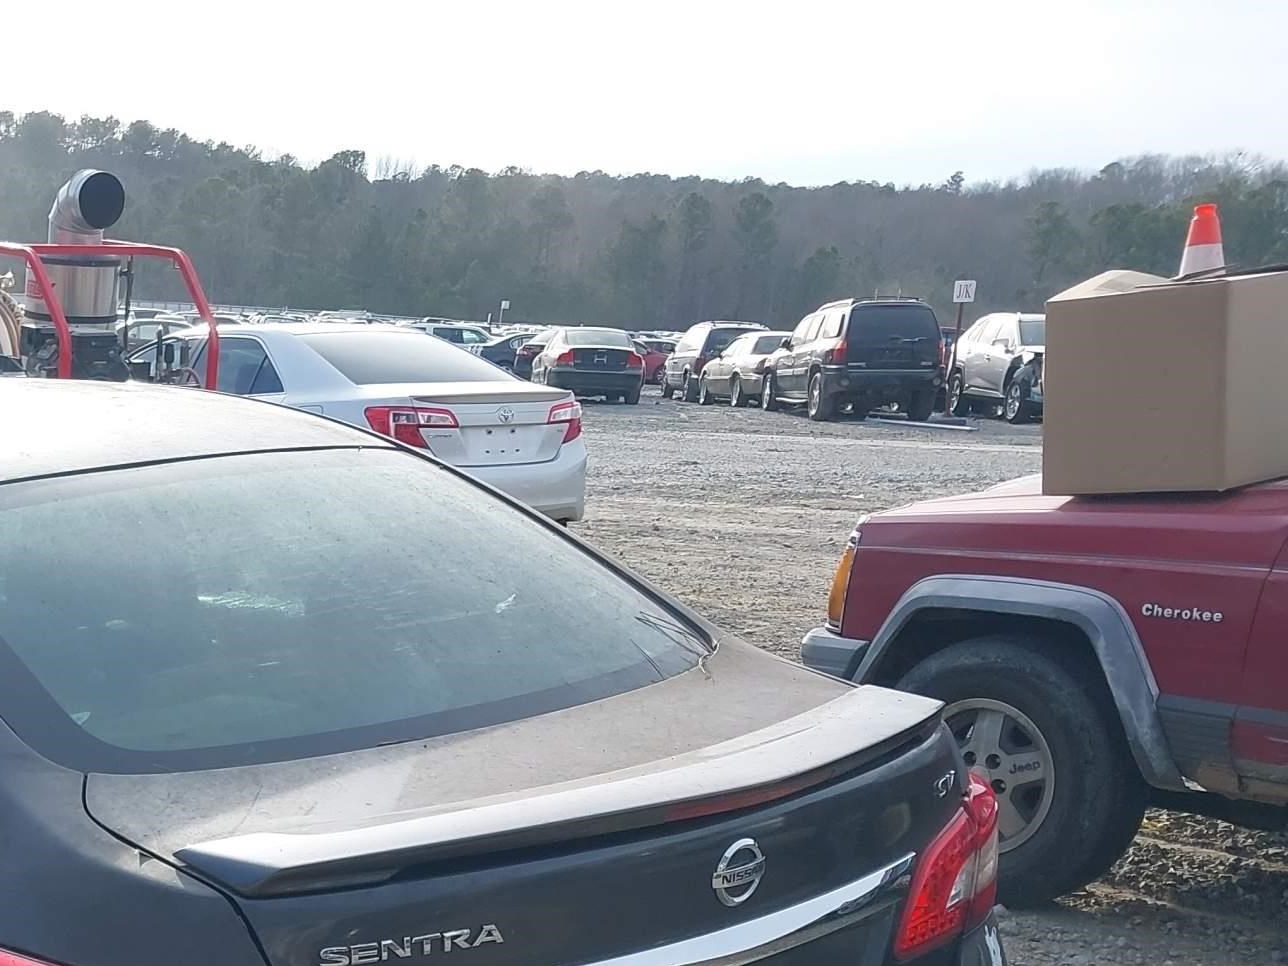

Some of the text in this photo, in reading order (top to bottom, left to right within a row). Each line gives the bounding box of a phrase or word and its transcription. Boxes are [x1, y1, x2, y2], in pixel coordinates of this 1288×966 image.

[1141, 603, 1223, 622] Cherokee
[1009, 761, 1041, 775] Jeep
[721, 861, 763, 885] NISSA
